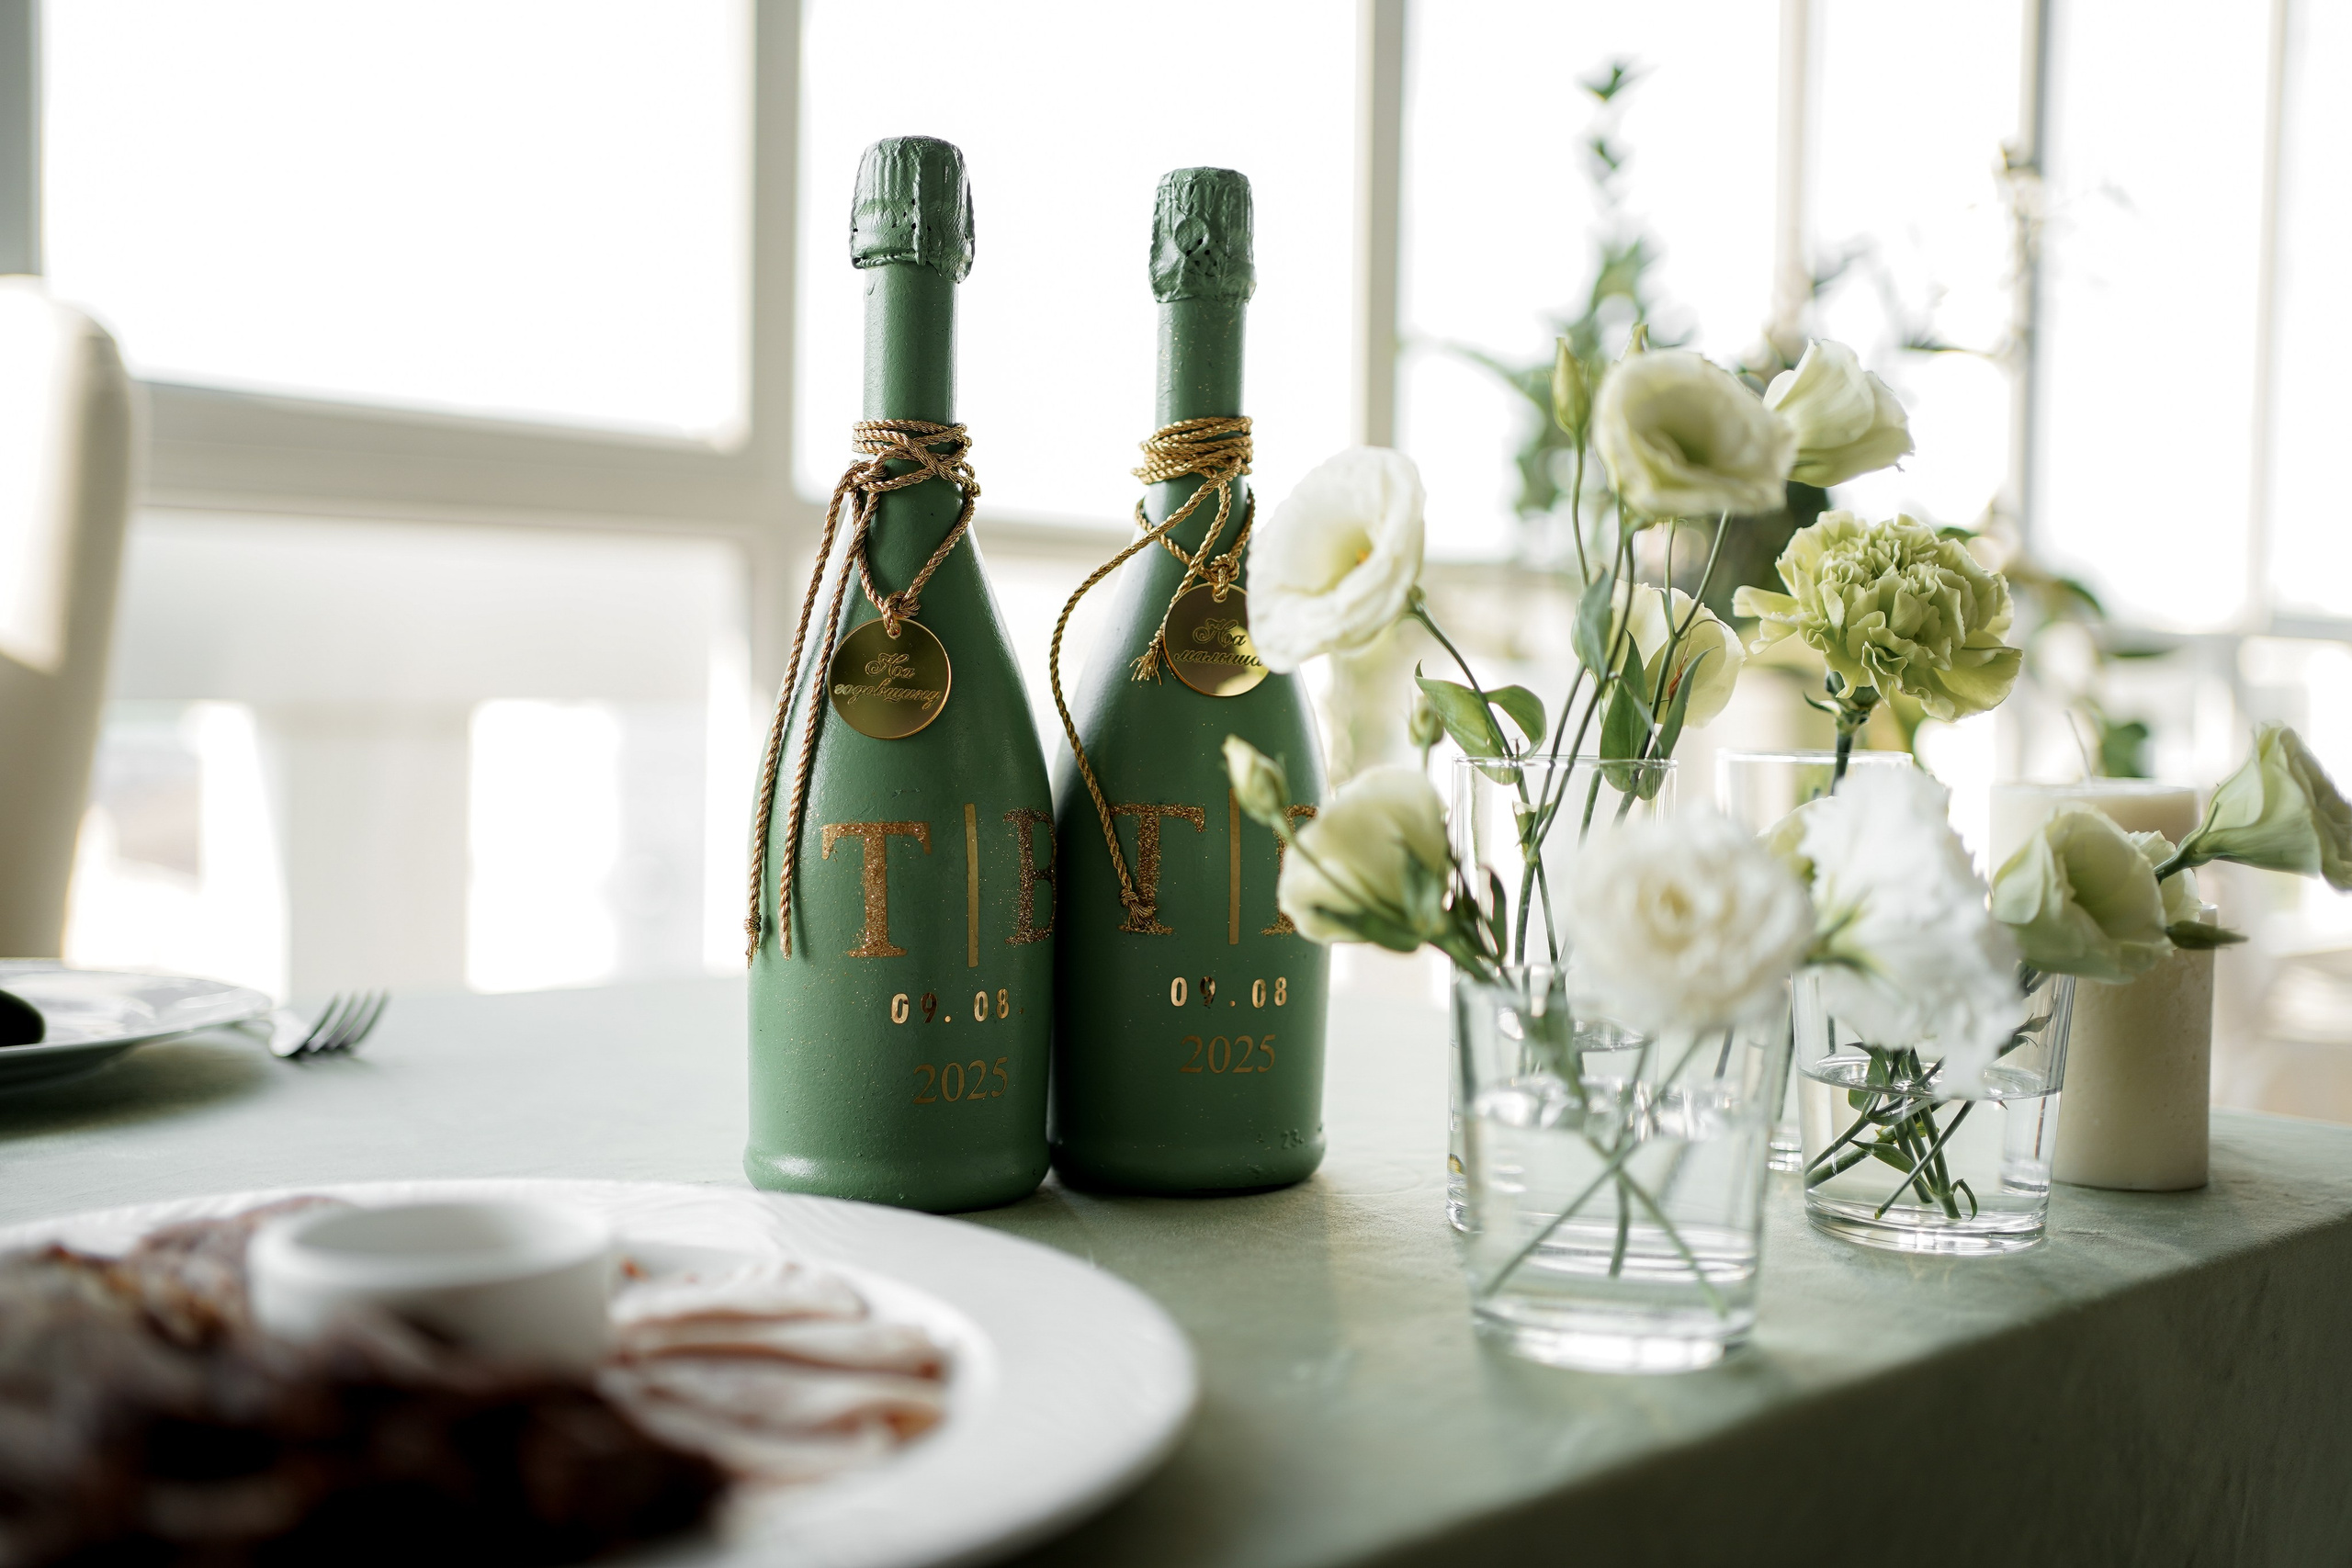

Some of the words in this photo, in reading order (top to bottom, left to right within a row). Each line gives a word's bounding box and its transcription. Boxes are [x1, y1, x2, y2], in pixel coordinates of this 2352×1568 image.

[1193, 618, 1247, 648] На
[865, 652, 916, 679] На
[833, 678, 942, 711] годовщину
[1179, 1033, 1277, 1075] 2025
[912, 1056, 1010, 1105] 2025
